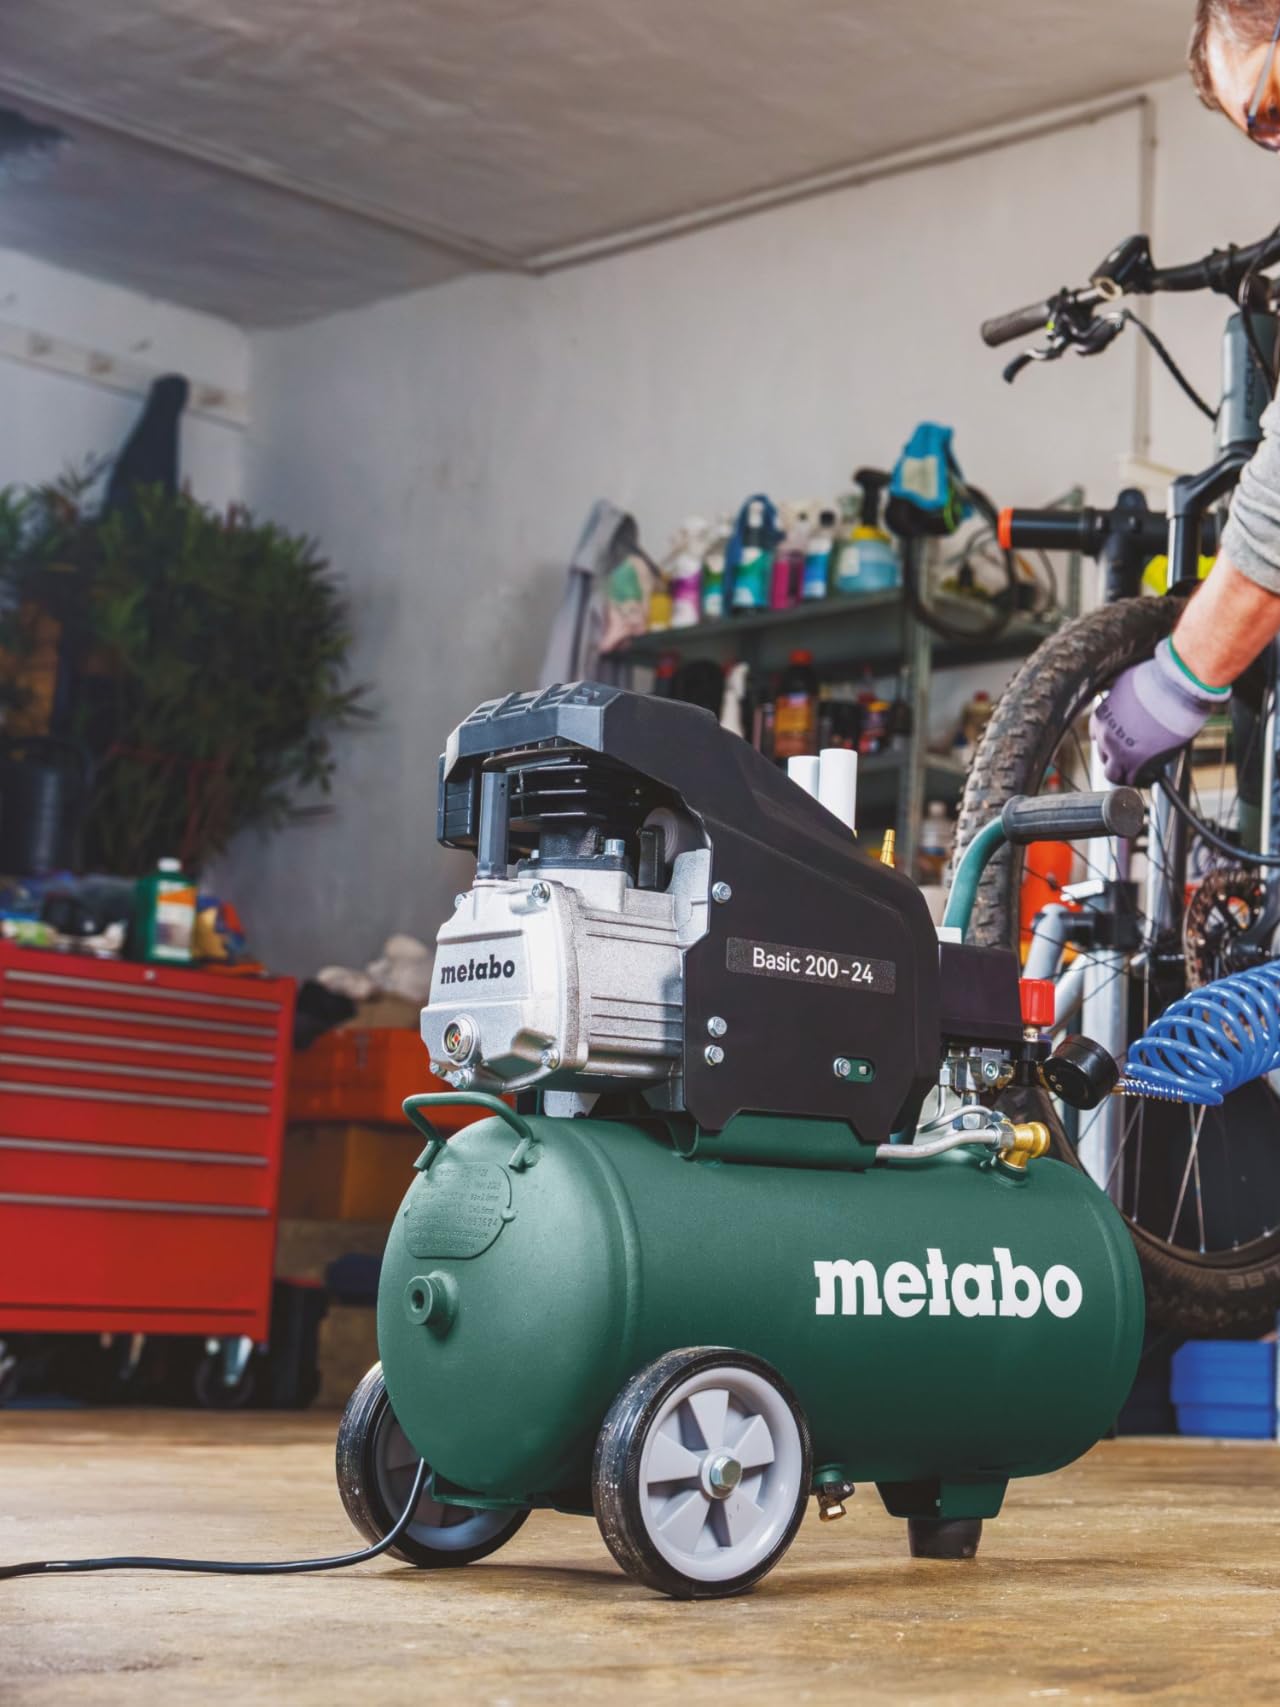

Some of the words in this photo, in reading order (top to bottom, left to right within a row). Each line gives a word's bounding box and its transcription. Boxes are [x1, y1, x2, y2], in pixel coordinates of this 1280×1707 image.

[440, 953, 515, 984] metabo
[753, 947, 800, 973] Basic
[813, 1247, 1083, 1318] metabo
